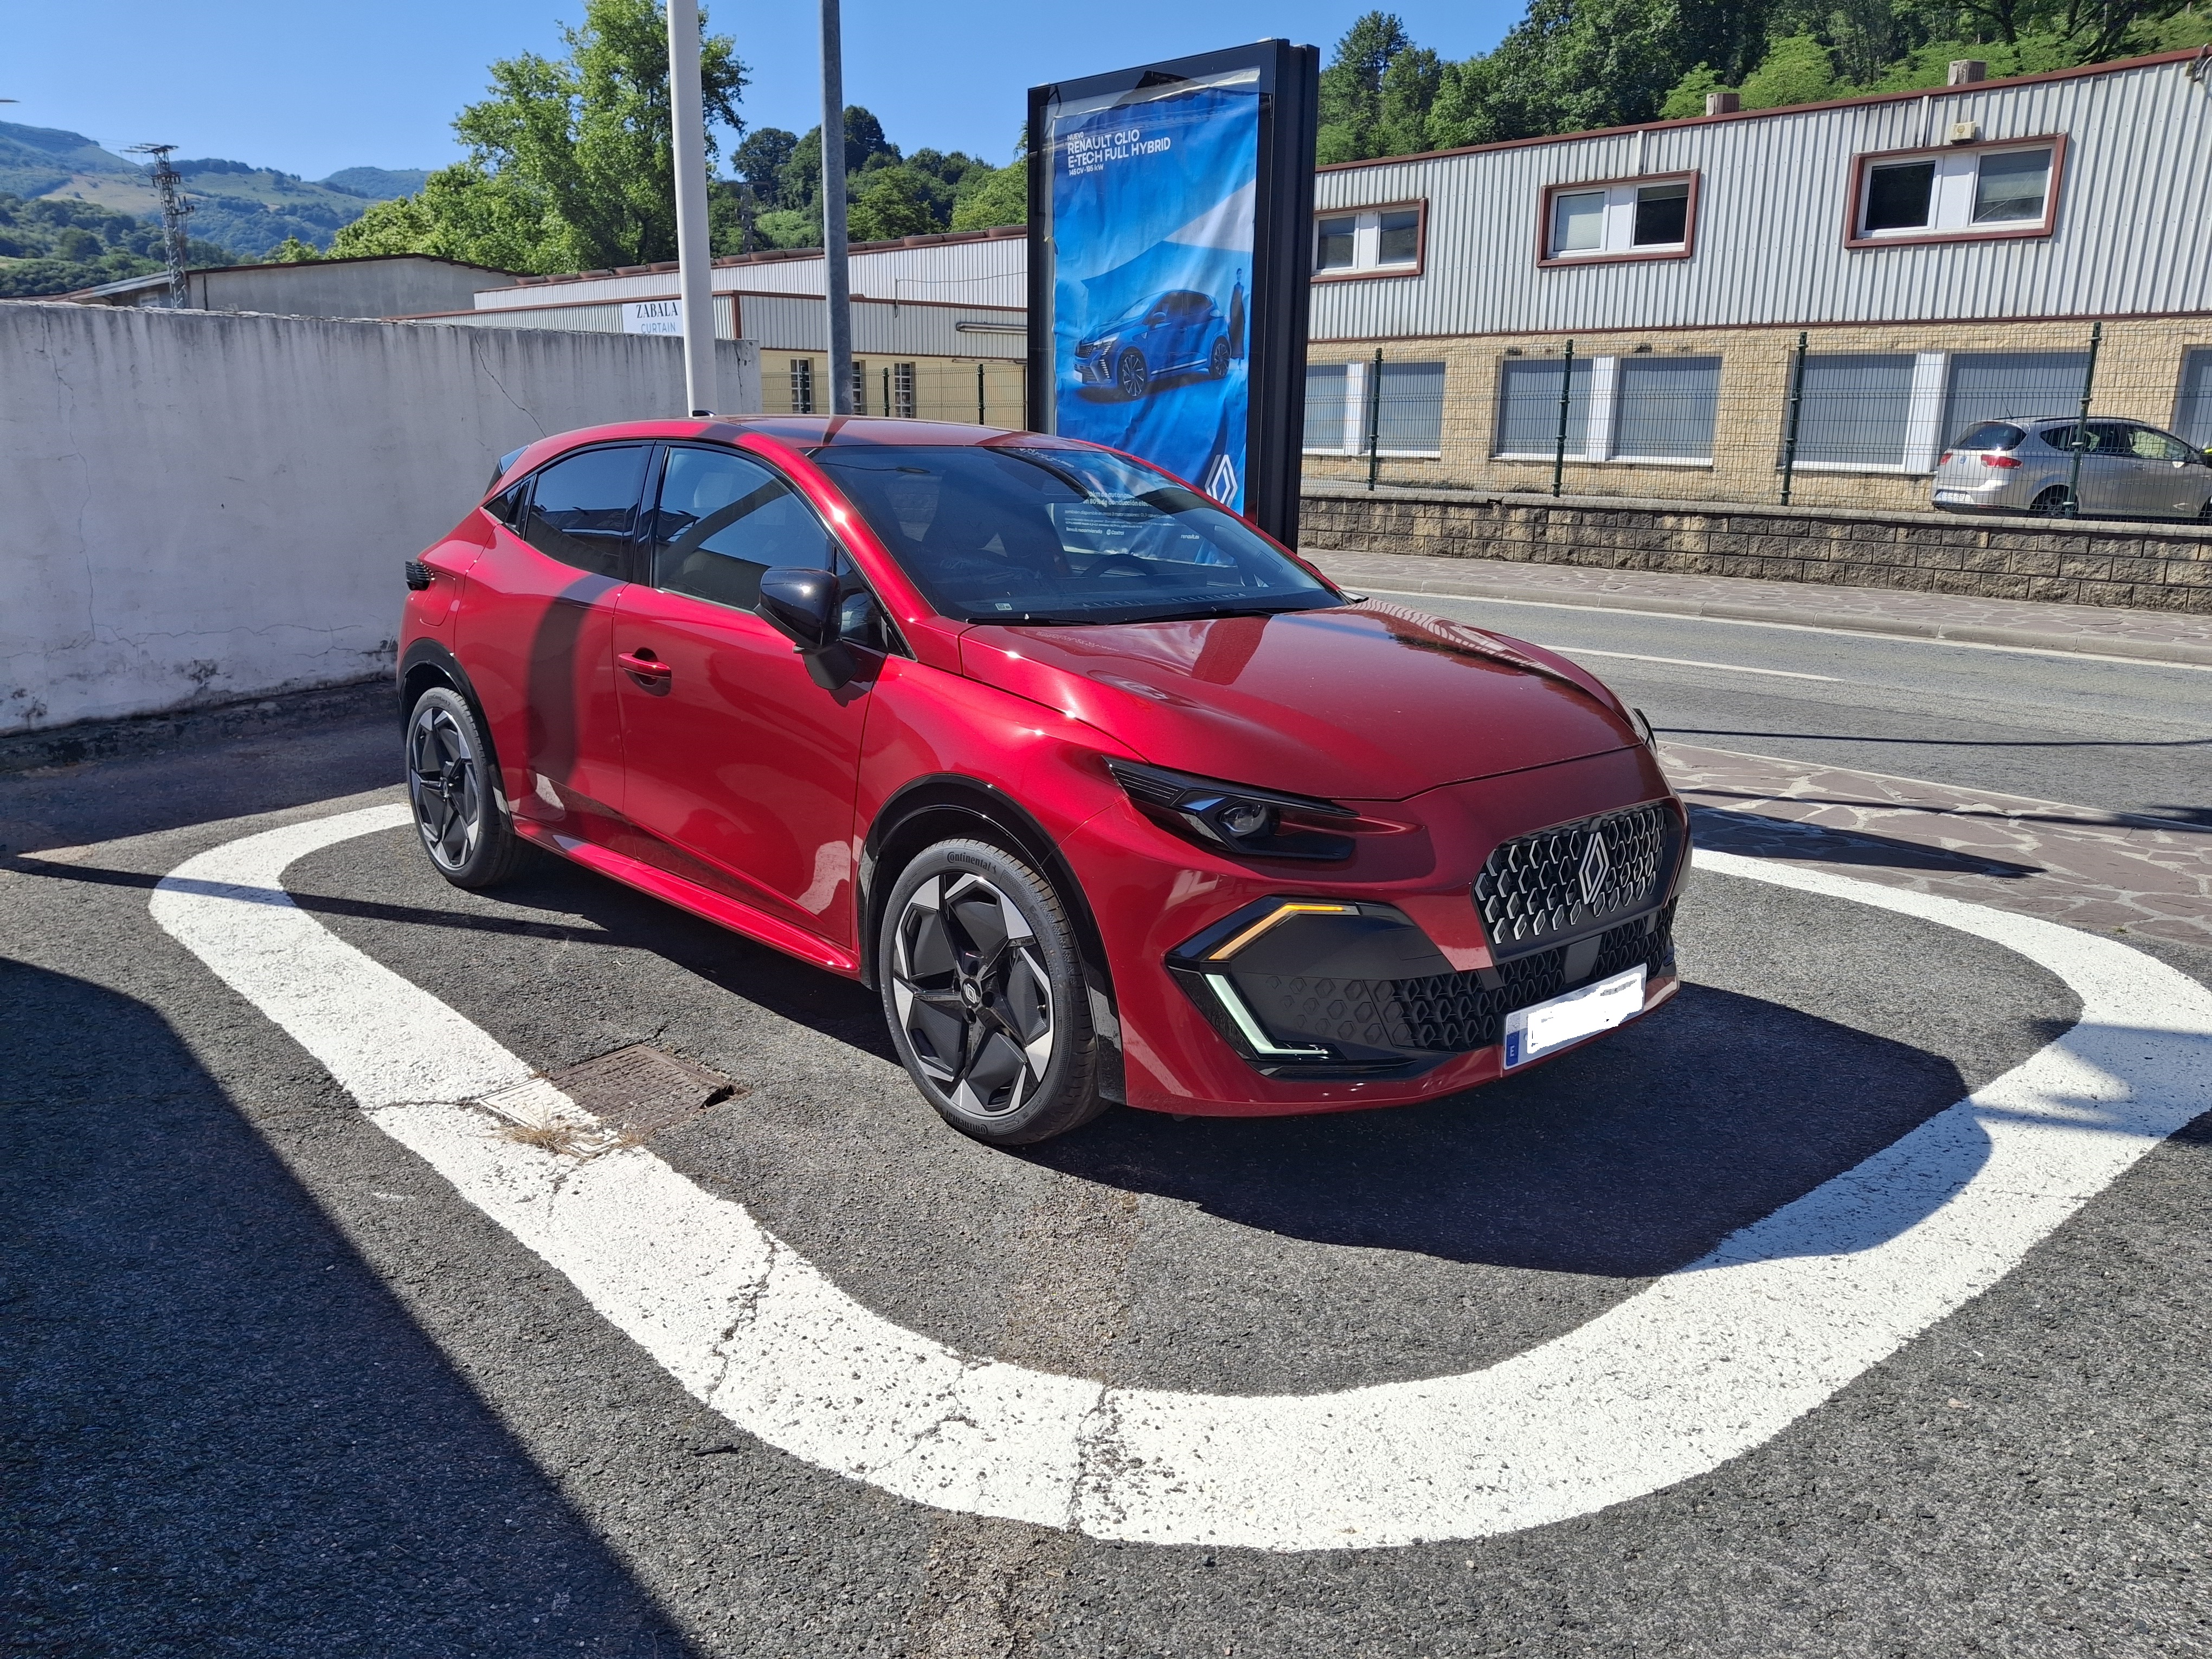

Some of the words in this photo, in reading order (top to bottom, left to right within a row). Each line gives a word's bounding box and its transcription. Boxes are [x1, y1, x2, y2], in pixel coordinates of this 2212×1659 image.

[1067, 131, 1084, 142] NUEVO
[1068, 134, 1111, 155] RENAULT
[1114, 129, 1140, 145] CLIO
[1068, 150, 1103, 168] E-TECH
[1105, 145, 1129, 162] FULL
[1131, 137, 1171, 156] HYBRID
[636, 301, 678, 318] ZABALA
[641, 322, 676, 333] CURTAIN
[947, 851, 992, 871] Continental
[1510, 1045, 1515, 1057] E
[946, 1110, 989, 1135] Continental
